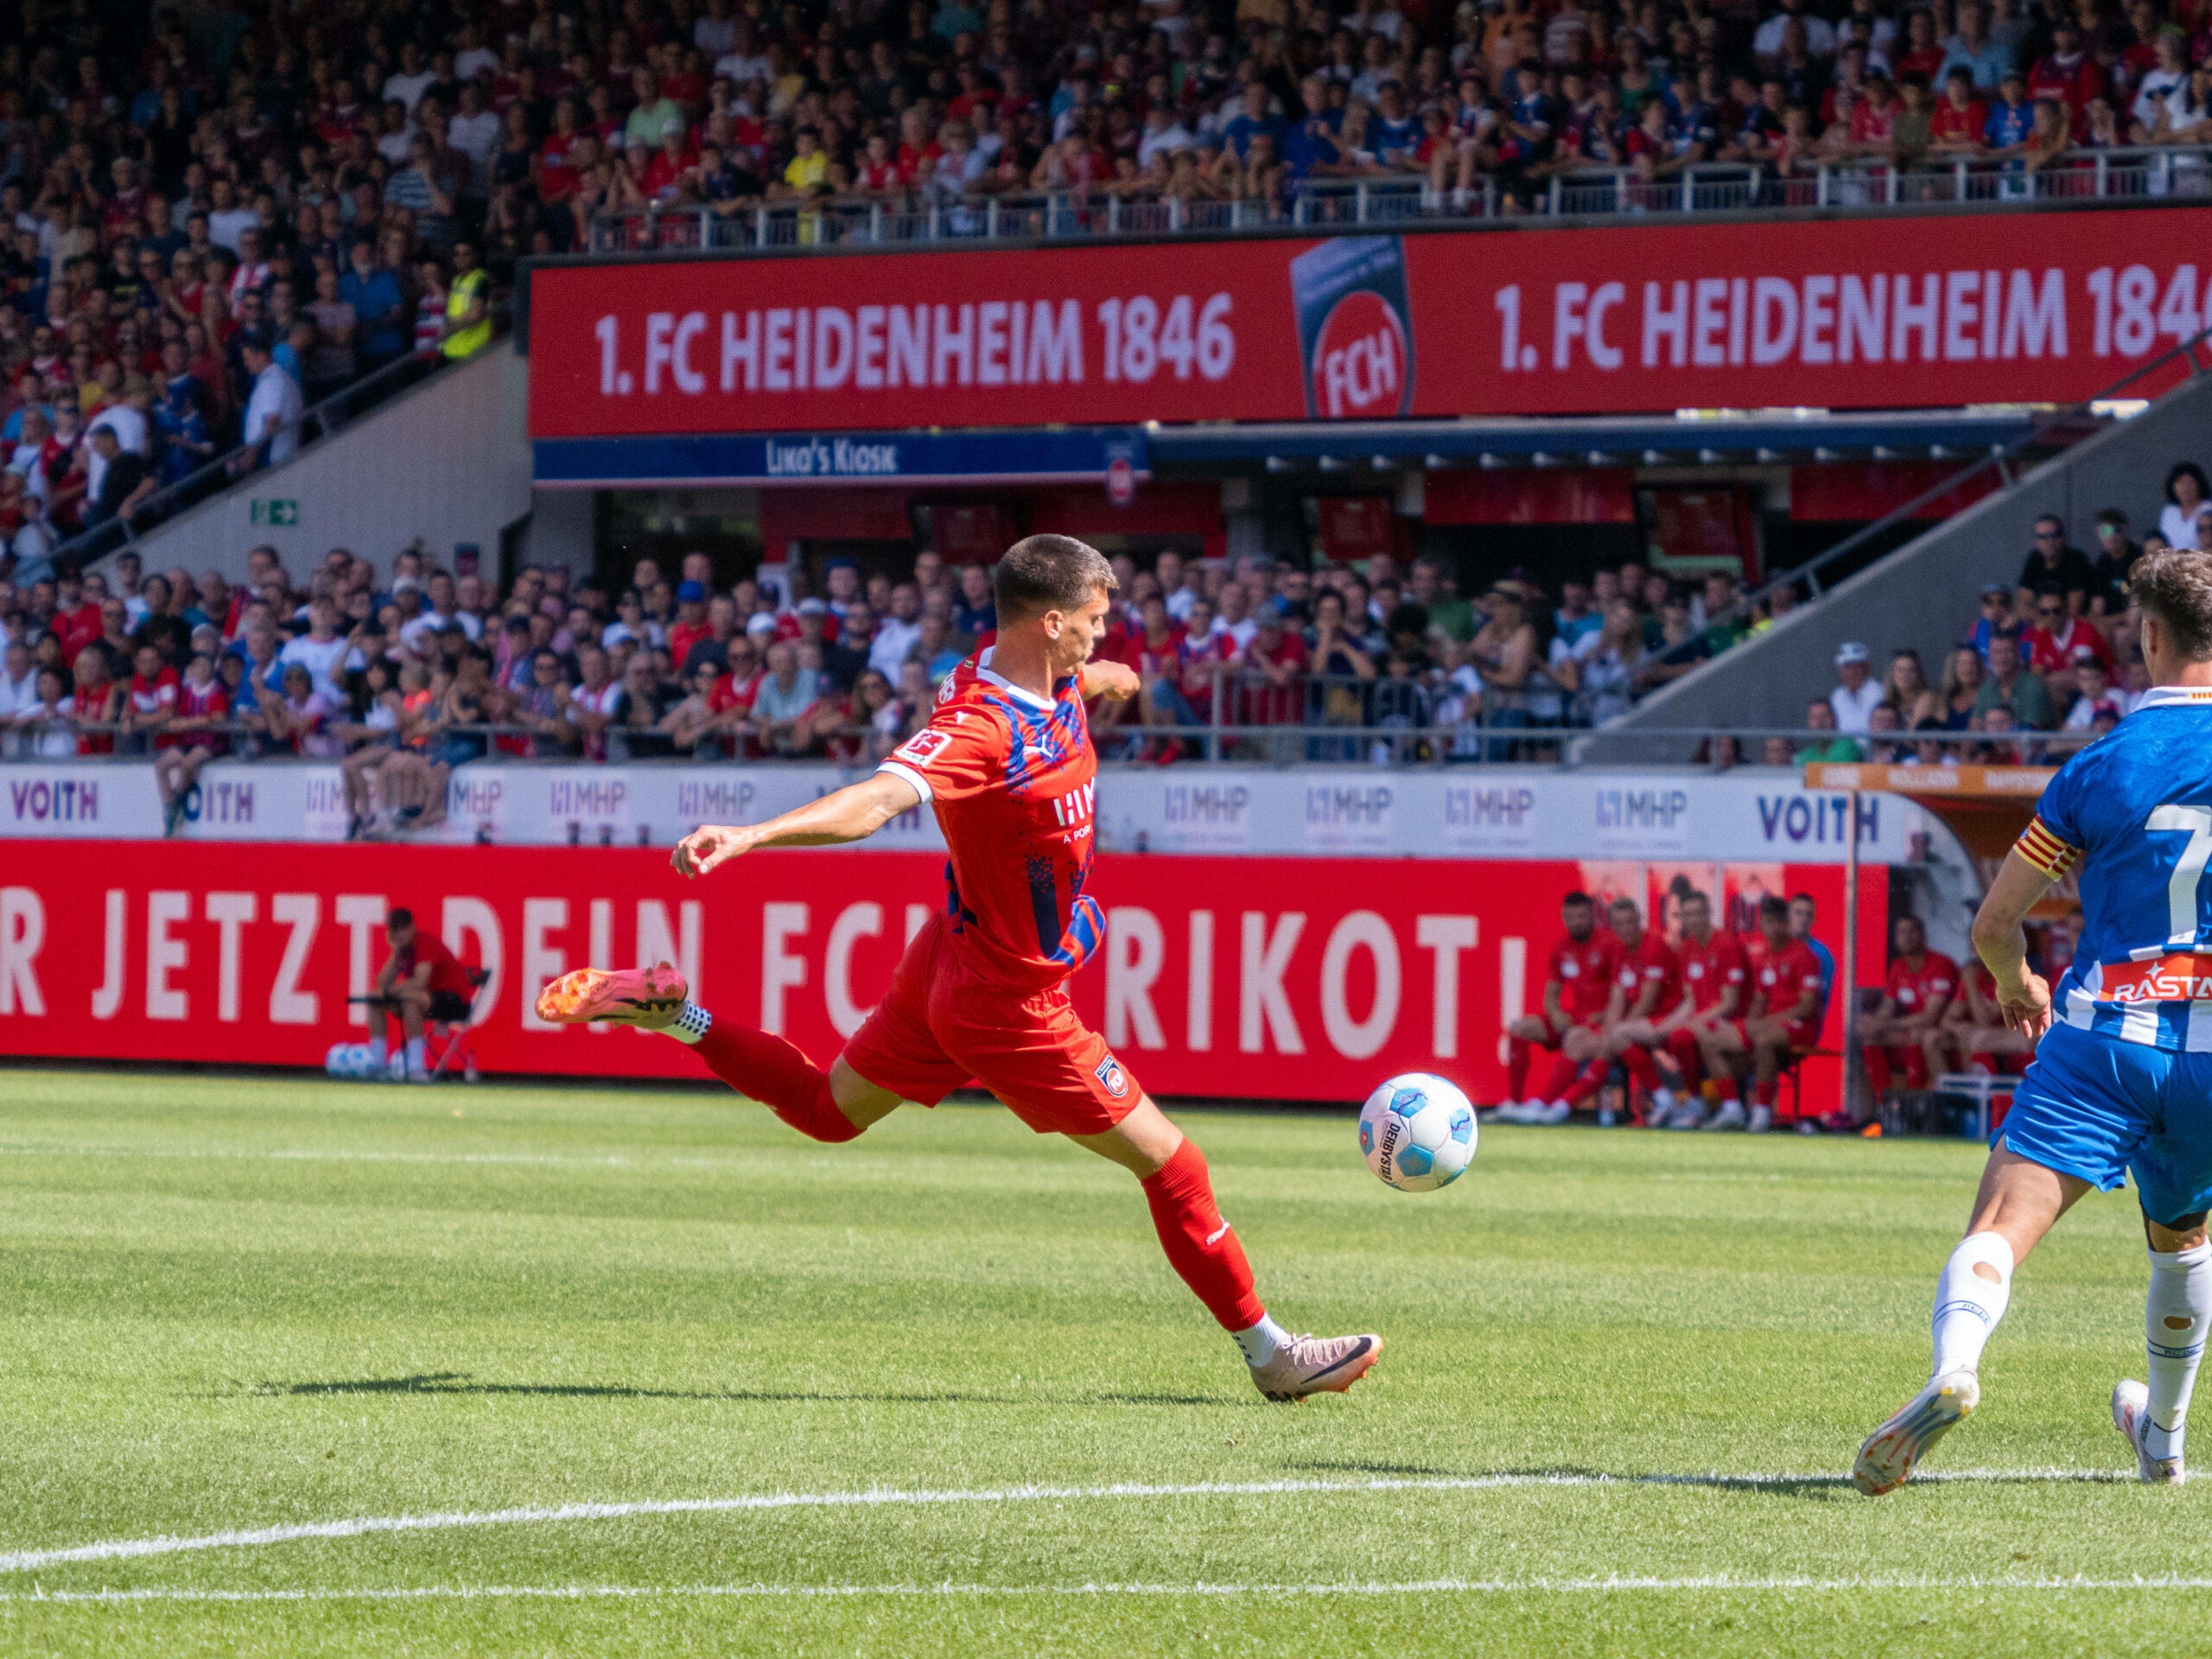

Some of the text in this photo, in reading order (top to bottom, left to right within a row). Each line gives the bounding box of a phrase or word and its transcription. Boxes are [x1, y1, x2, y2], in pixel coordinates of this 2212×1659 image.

[596, 292, 1235, 395] 1. FC HEIDENHEIM 1846
[1495, 284, 1537, 371] 1.
[1554, 281, 1625, 370] FC
[1642, 268, 2068, 367] HEIDENHEIM
[1325, 327, 1397, 417] FCH
[10, 779, 98, 822] VOITH
[181, 780, 255, 823] OITH
[575, 780, 626, 817] MHP
[704, 782, 753, 817] MHP
[1626, 789, 1687, 827] MHP
[1757, 795, 1880, 844] VOITH
[2144, 804, 2212, 944] 7
[92, 890, 388, 1027] JETZT
[442, 896, 703, 1034] DEIN
